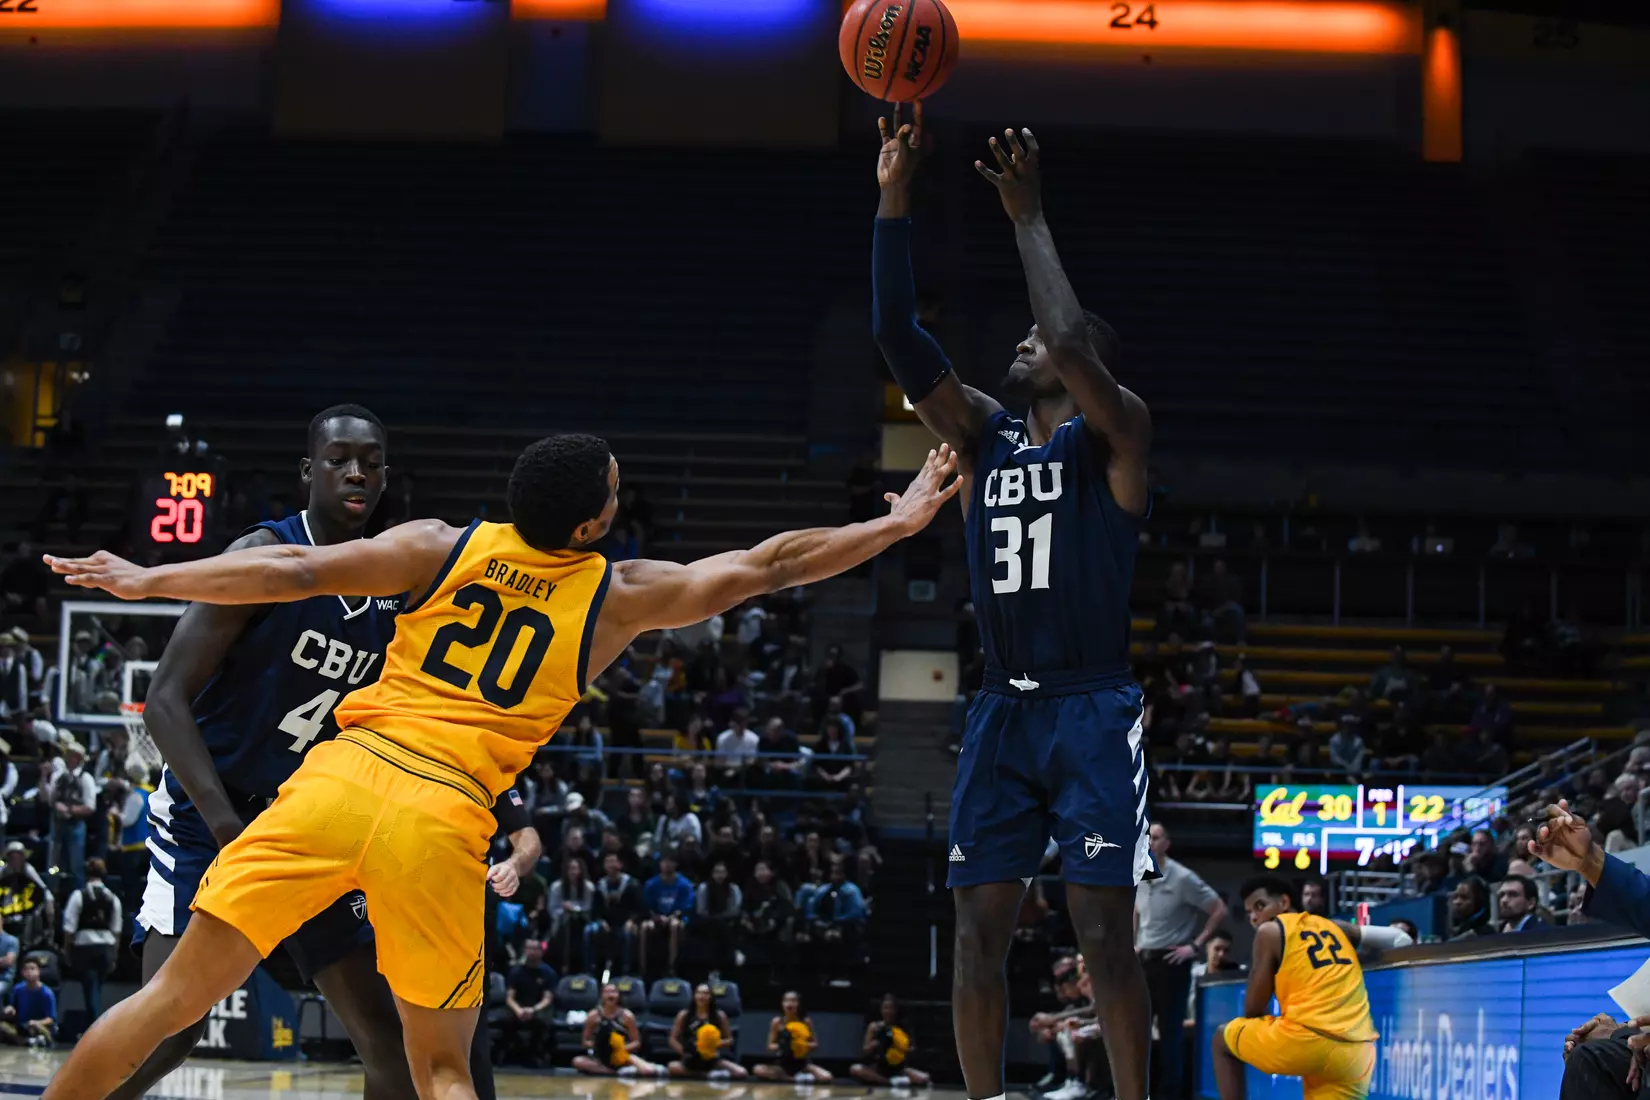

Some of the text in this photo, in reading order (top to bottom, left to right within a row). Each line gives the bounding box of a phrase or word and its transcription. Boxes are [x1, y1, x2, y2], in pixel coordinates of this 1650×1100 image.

[1110, 3, 1158, 30] 24
[864, 5, 903, 80] Wilson
[903, 26, 932, 83] NCAA
[163, 472, 212, 498] 7:09
[984, 462, 1063, 507] CBU
[150, 498, 204, 543] 20
[990, 512, 1053, 594] 31
[484, 558, 557, 602] BRADLEY
[376, 599, 400, 611] WAC
[291, 629, 379, 684] CBU
[420, 582, 555, 709] 20
[277, 688, 341, 753] 4
[1259, 787, 1353, 826] Cal 30
[1372, 801, 1387, 827] 1
[1409, 795, 1445, 823] 22
[1264, 846, 1311, 870] 3 6
[1300, 930, 1353, 969] 22
[1380, 1006, 1520, 1100] Honda Dealers
